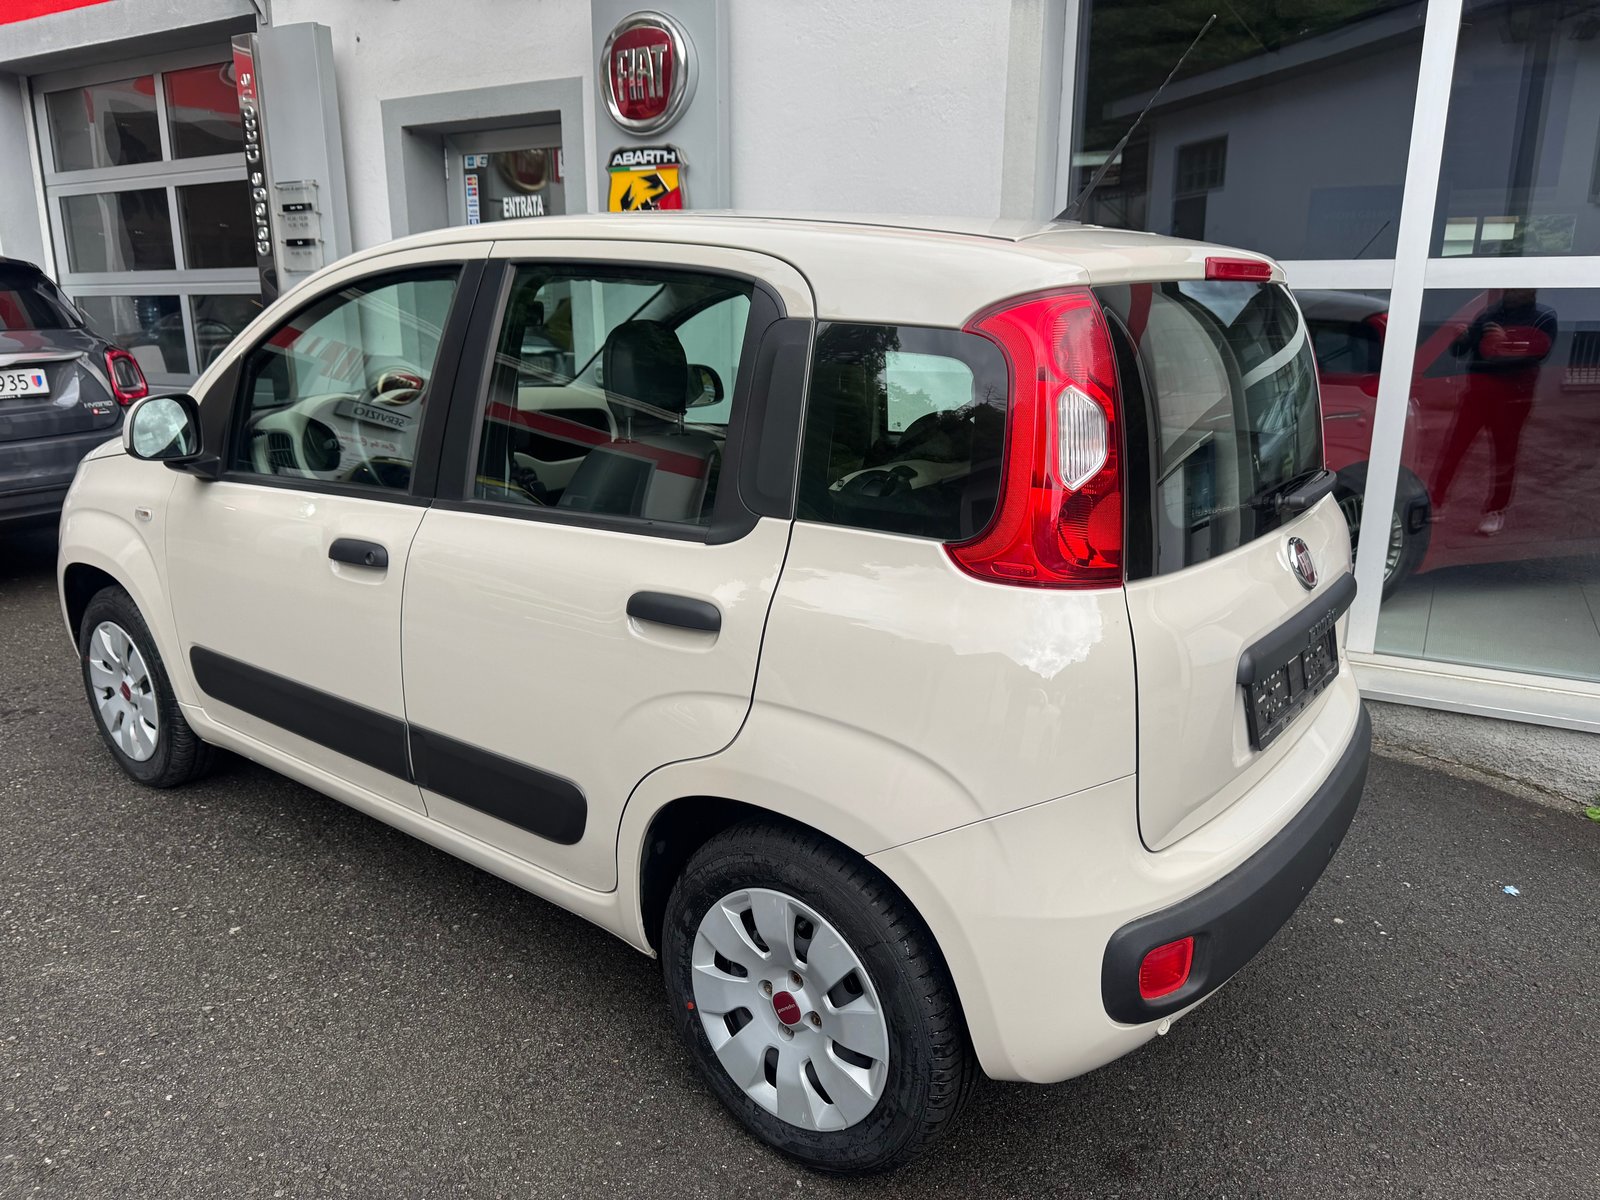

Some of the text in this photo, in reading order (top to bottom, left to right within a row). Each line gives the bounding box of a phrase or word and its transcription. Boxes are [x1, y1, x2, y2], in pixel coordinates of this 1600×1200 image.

[616, 43, 668, 102] FIAT
[240, 73, 269, 256] Garage Ciccone
[612, 150, 676, 166] ABARTH
[502, 194, 545, 218] ENTRATA
